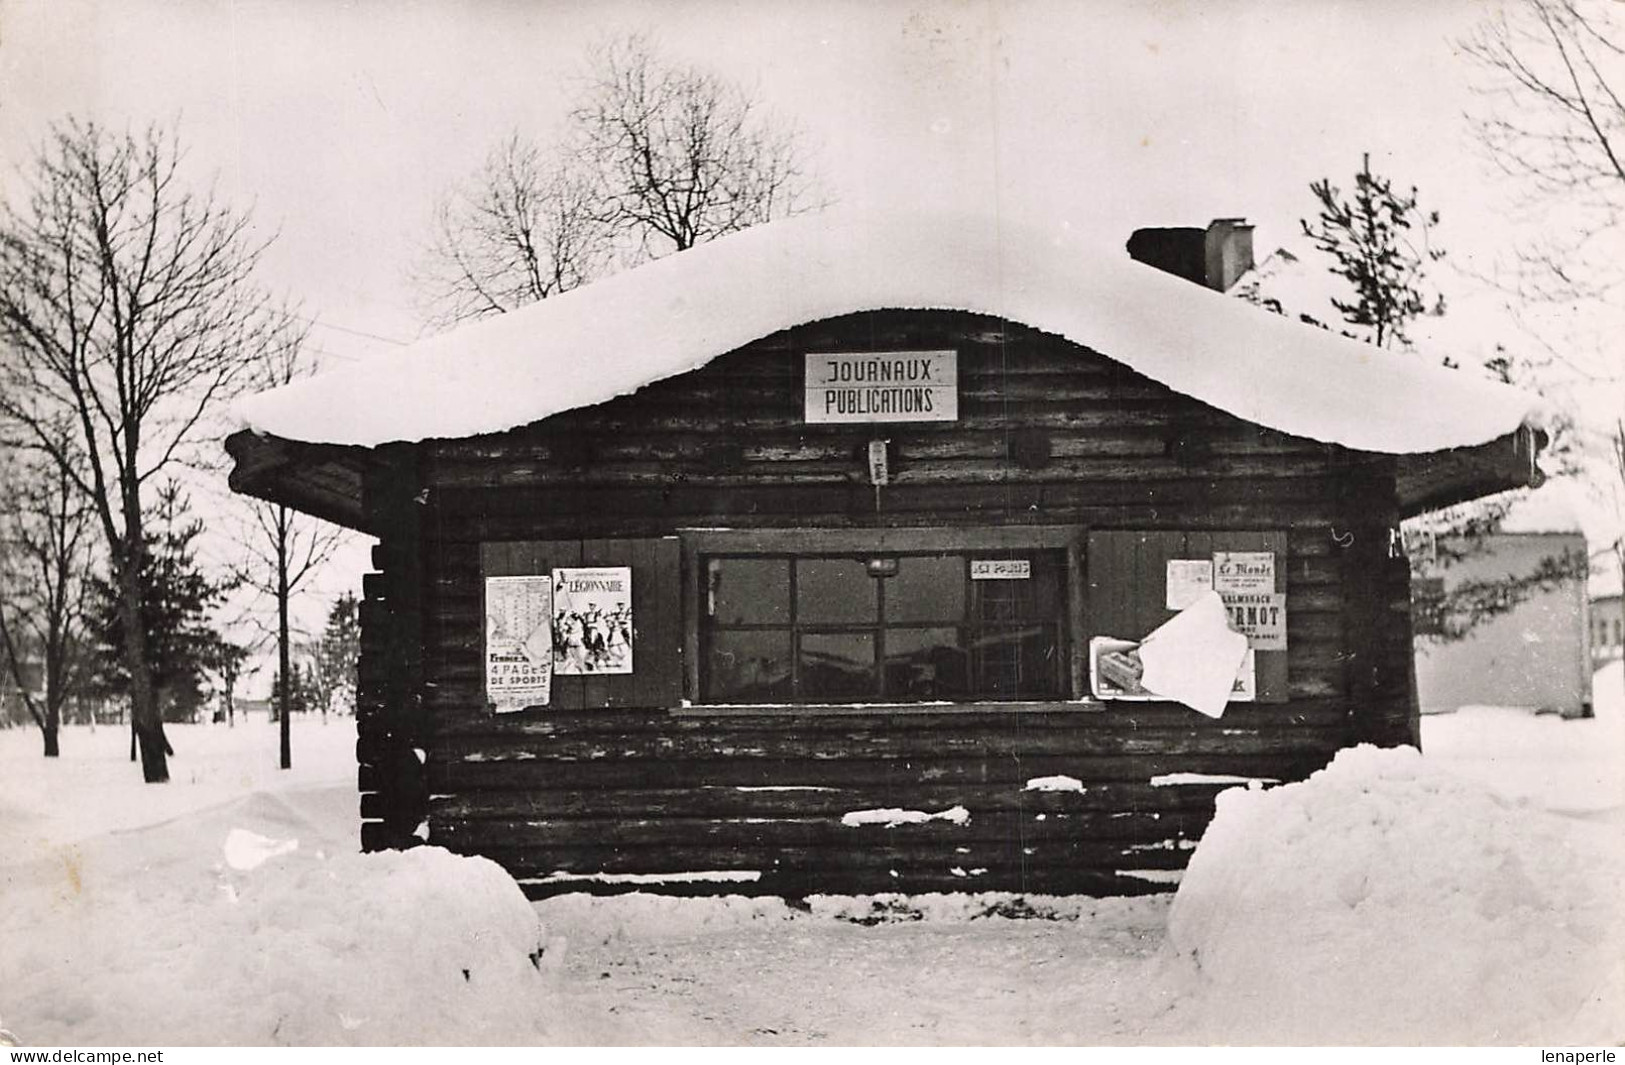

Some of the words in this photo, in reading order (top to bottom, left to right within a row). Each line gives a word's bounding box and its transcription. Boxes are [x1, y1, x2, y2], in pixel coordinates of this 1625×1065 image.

[827, 359, 932, 382] JOURNAUX
[825, 388, 933, 414] PUBLICATIONS
[1235, 563, 1271, 574] Monde
[509, 675, 547, 685] SPORTS
